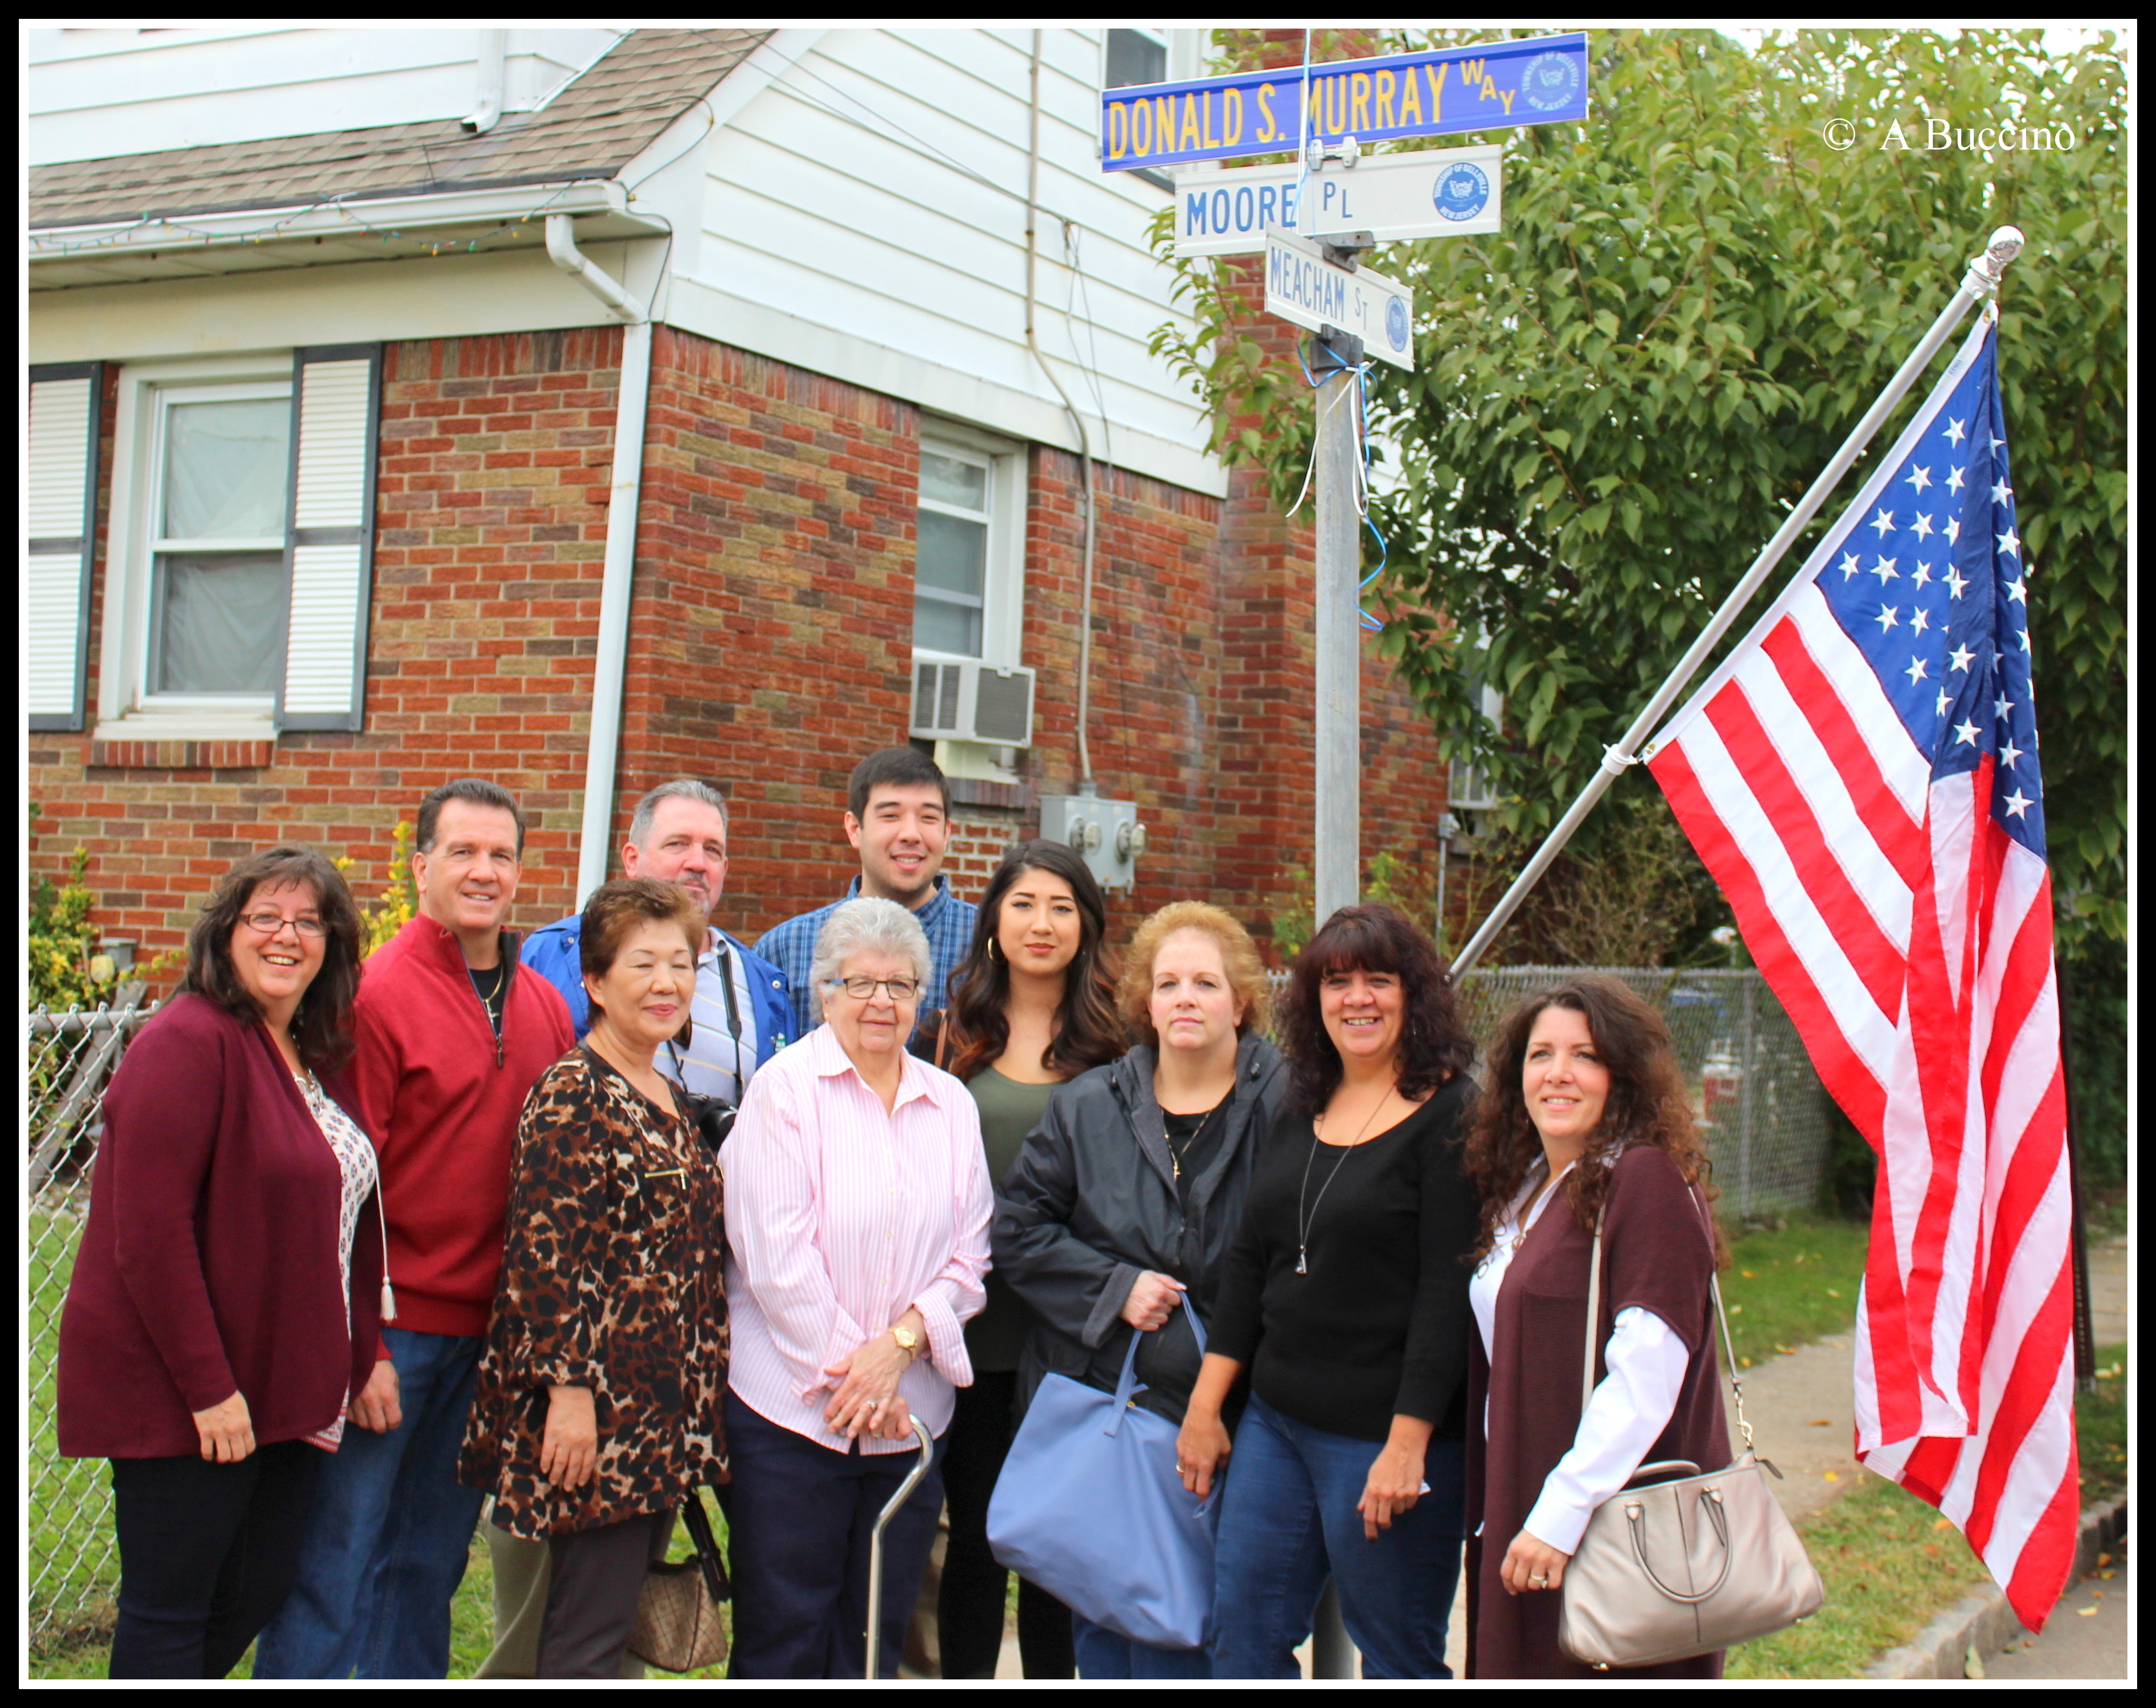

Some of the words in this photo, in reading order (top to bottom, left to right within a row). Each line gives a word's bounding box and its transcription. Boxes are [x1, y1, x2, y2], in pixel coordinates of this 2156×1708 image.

[1110, 87, 1243, 160] DONALD
[1256, 82, 1286, 143] S.
[1300, 62, 1449, 136] MURRAY
[1460, 58, 1516, 115] WAY
[1187, 183, 1297, 236] MOORE
[1324, 181, 1353, 218] PL
[1434, 166, 1454, 198] TOWNSHIP
[1439, 205, 1456, 219] NEW
[1454, 203, 1480, 220] JERSEY
[1271, 246, 1344, 323] MEACHAM
[1355, 286, 1367, 331] ST
